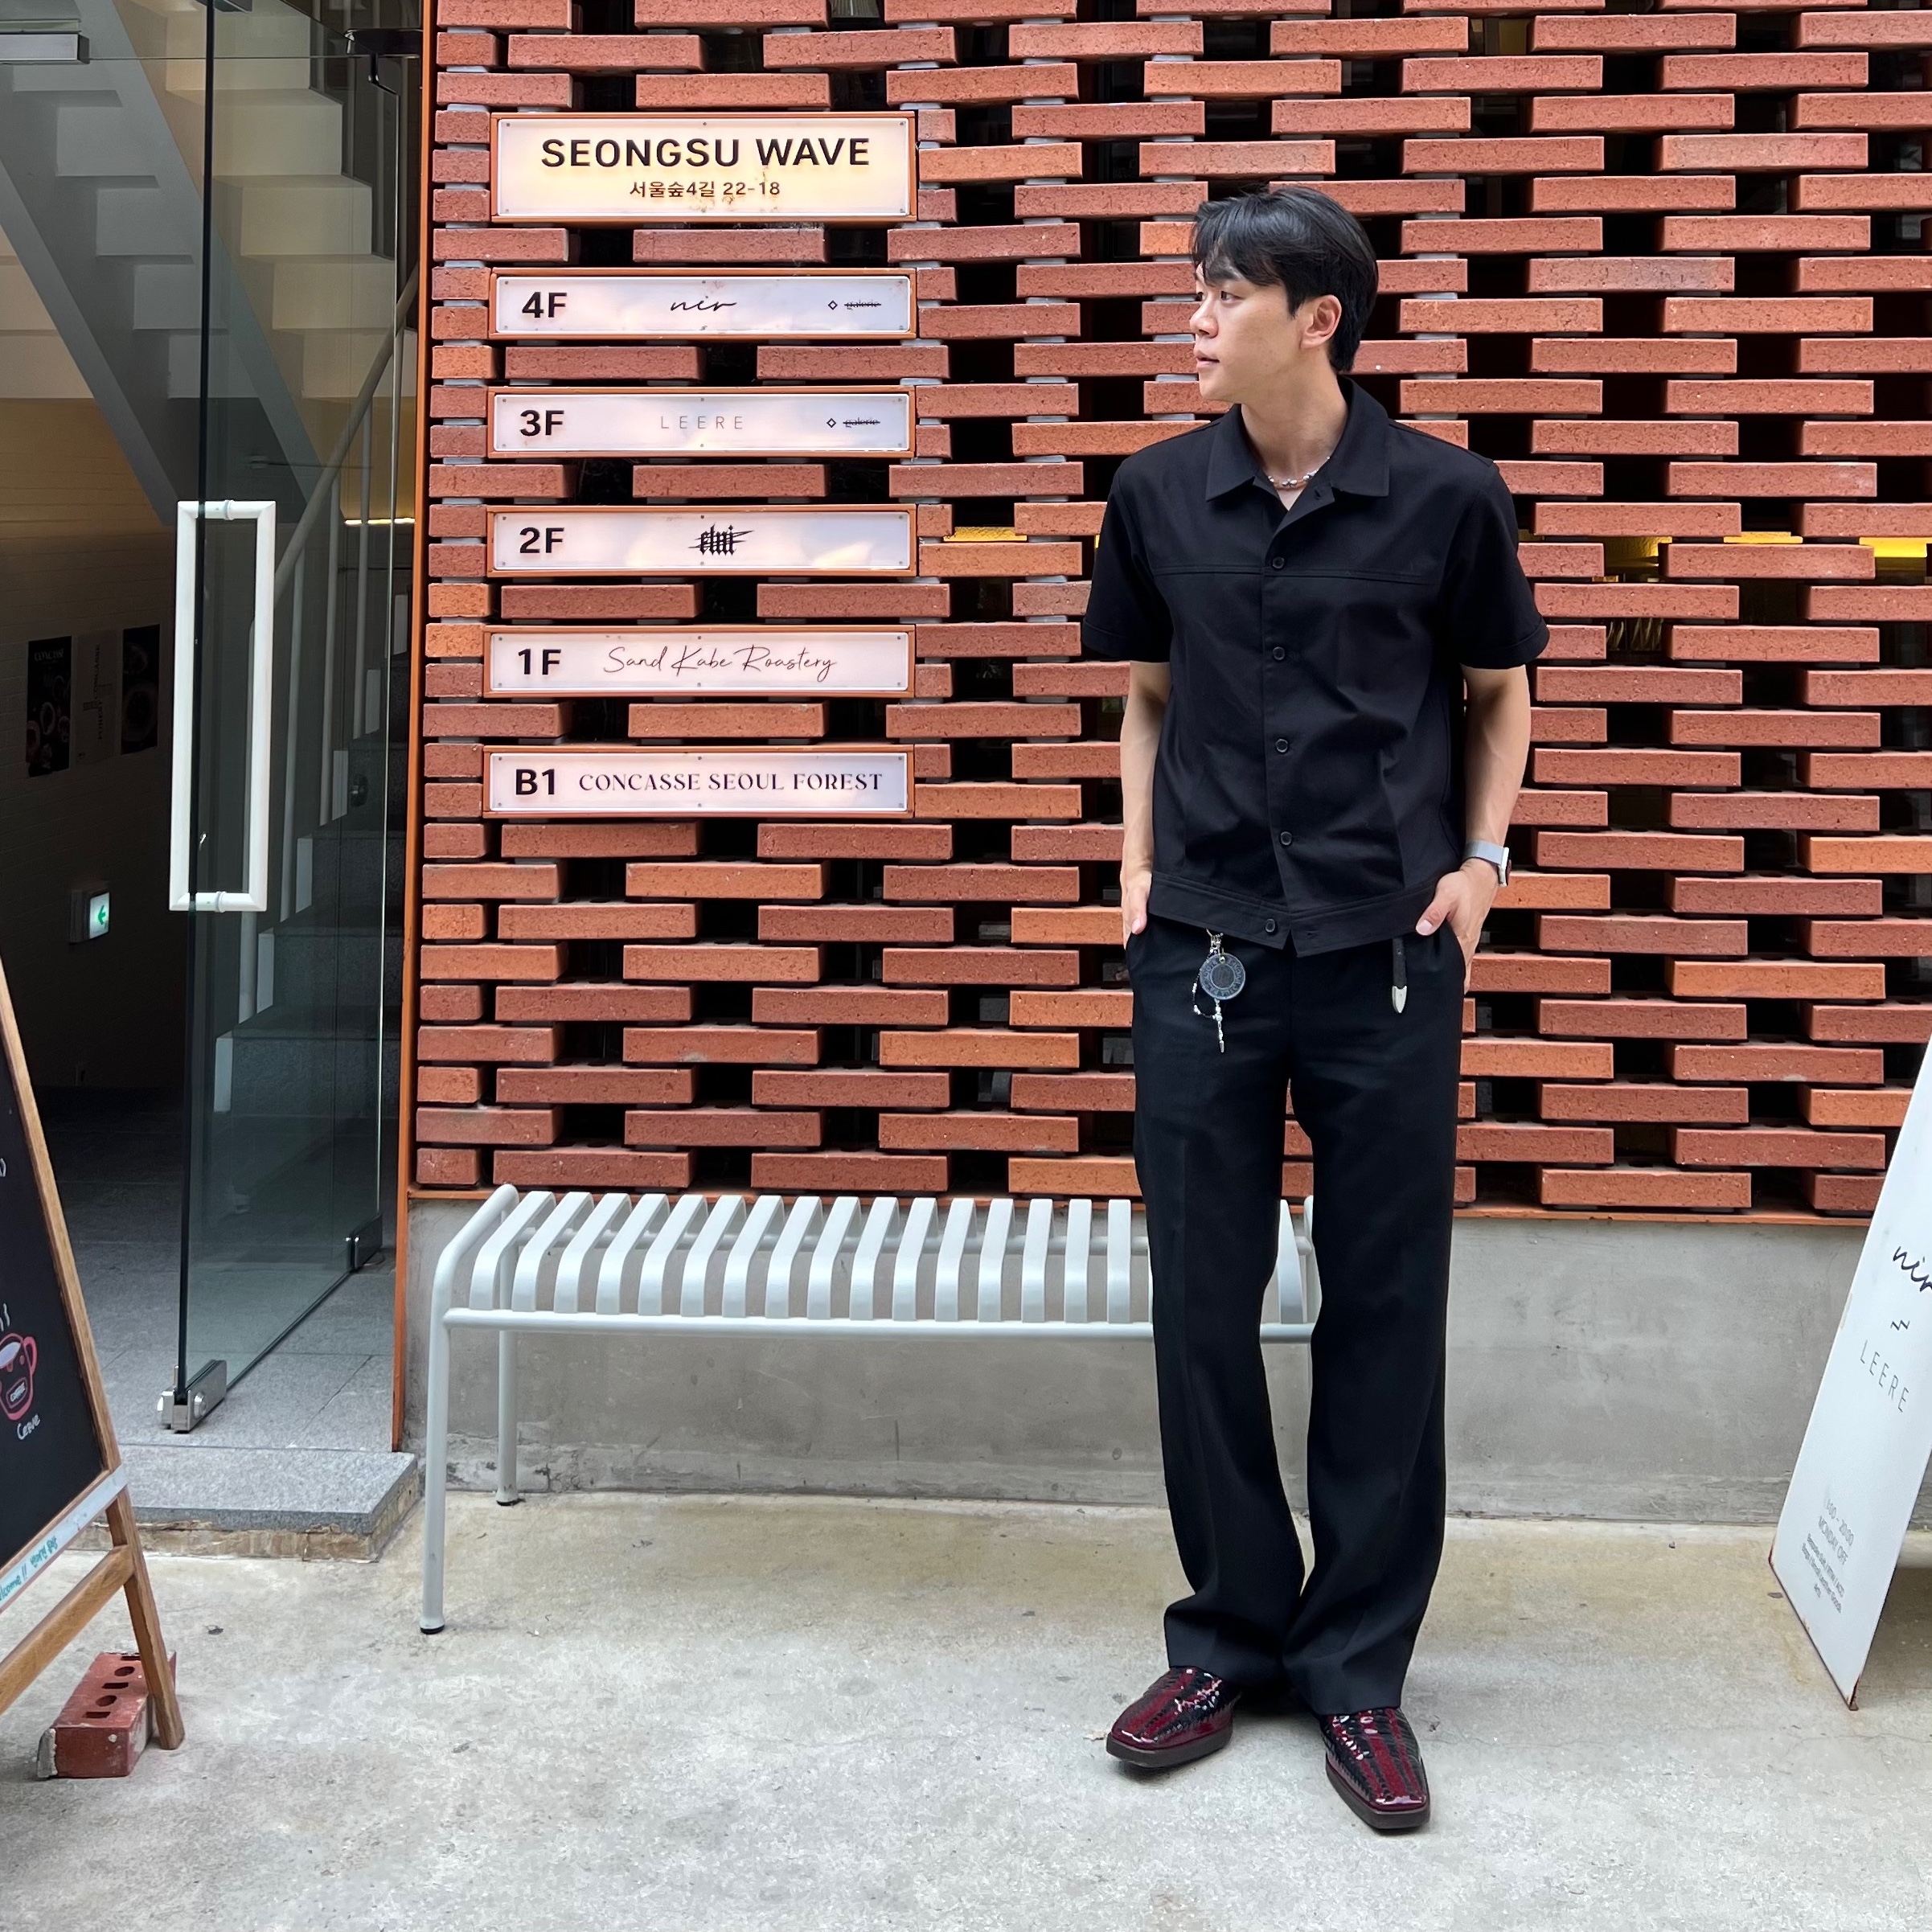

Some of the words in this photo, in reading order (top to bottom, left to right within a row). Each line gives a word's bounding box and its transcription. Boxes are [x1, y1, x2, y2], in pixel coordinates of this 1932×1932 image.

[541, 138, 740, 167] SEONGSU
[756, 137, 870, 166] WAVE
[630, 181, 715, 199] 서울숲4길
[722, 182, 781, 198] 22-18
[521, 291, 568, 319] 4F
[519, 409, 565, 437] 3F
[660, 416, 743, 430] LEERE
[519, 527, 565, 554] 2F
[517, 648, 562, 676] 1F
[604, 646, 668, 674] Sand
[671, 645, 732, 677] Kabe
[733, 644, 837, 683] Roastery
[515, 769, 556, 796] B1
[579, 773, 700, 791] CONCASSE
[708, 773, 784, 790] SEOUL
[794, 773, 883, 790] FOREST
[1860, 1339, 1909, 1413] LEERE
